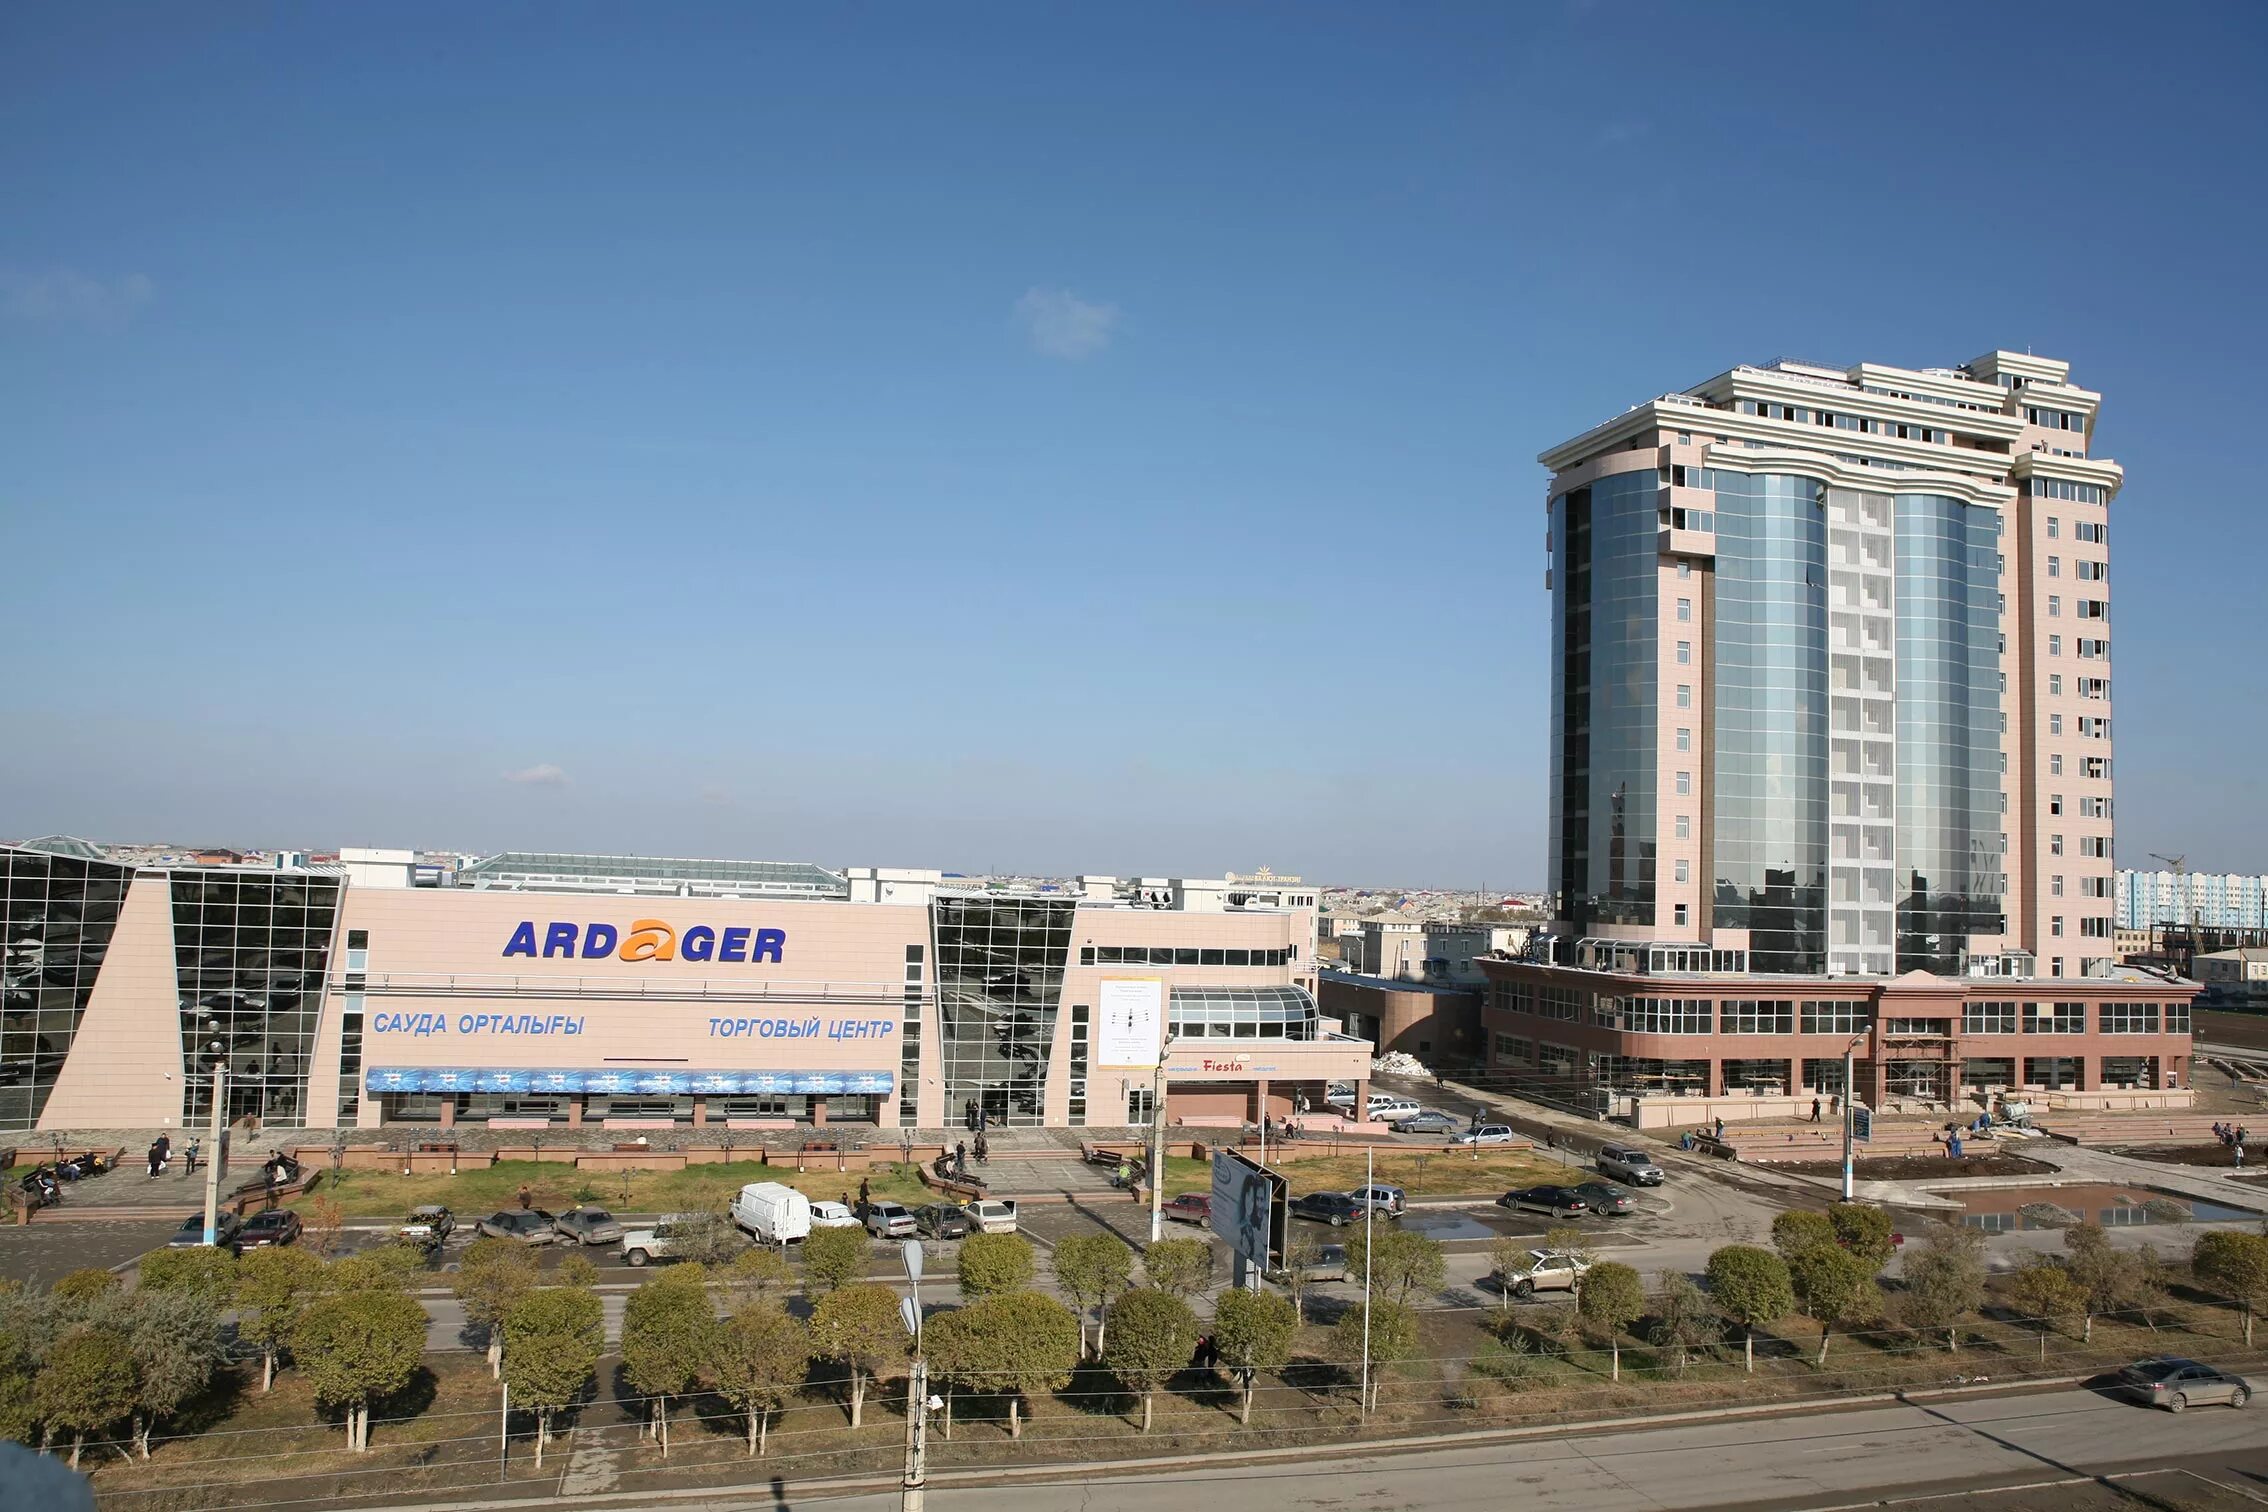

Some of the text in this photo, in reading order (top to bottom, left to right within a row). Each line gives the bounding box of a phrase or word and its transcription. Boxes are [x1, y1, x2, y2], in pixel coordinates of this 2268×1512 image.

[373, 1013, 447, 1037] САУДА
[709, 1016, 893, 1042] ТОРГОВЫЙ ЦЕНТР
[1203, 1059, 1243, 1072] Fiesta
